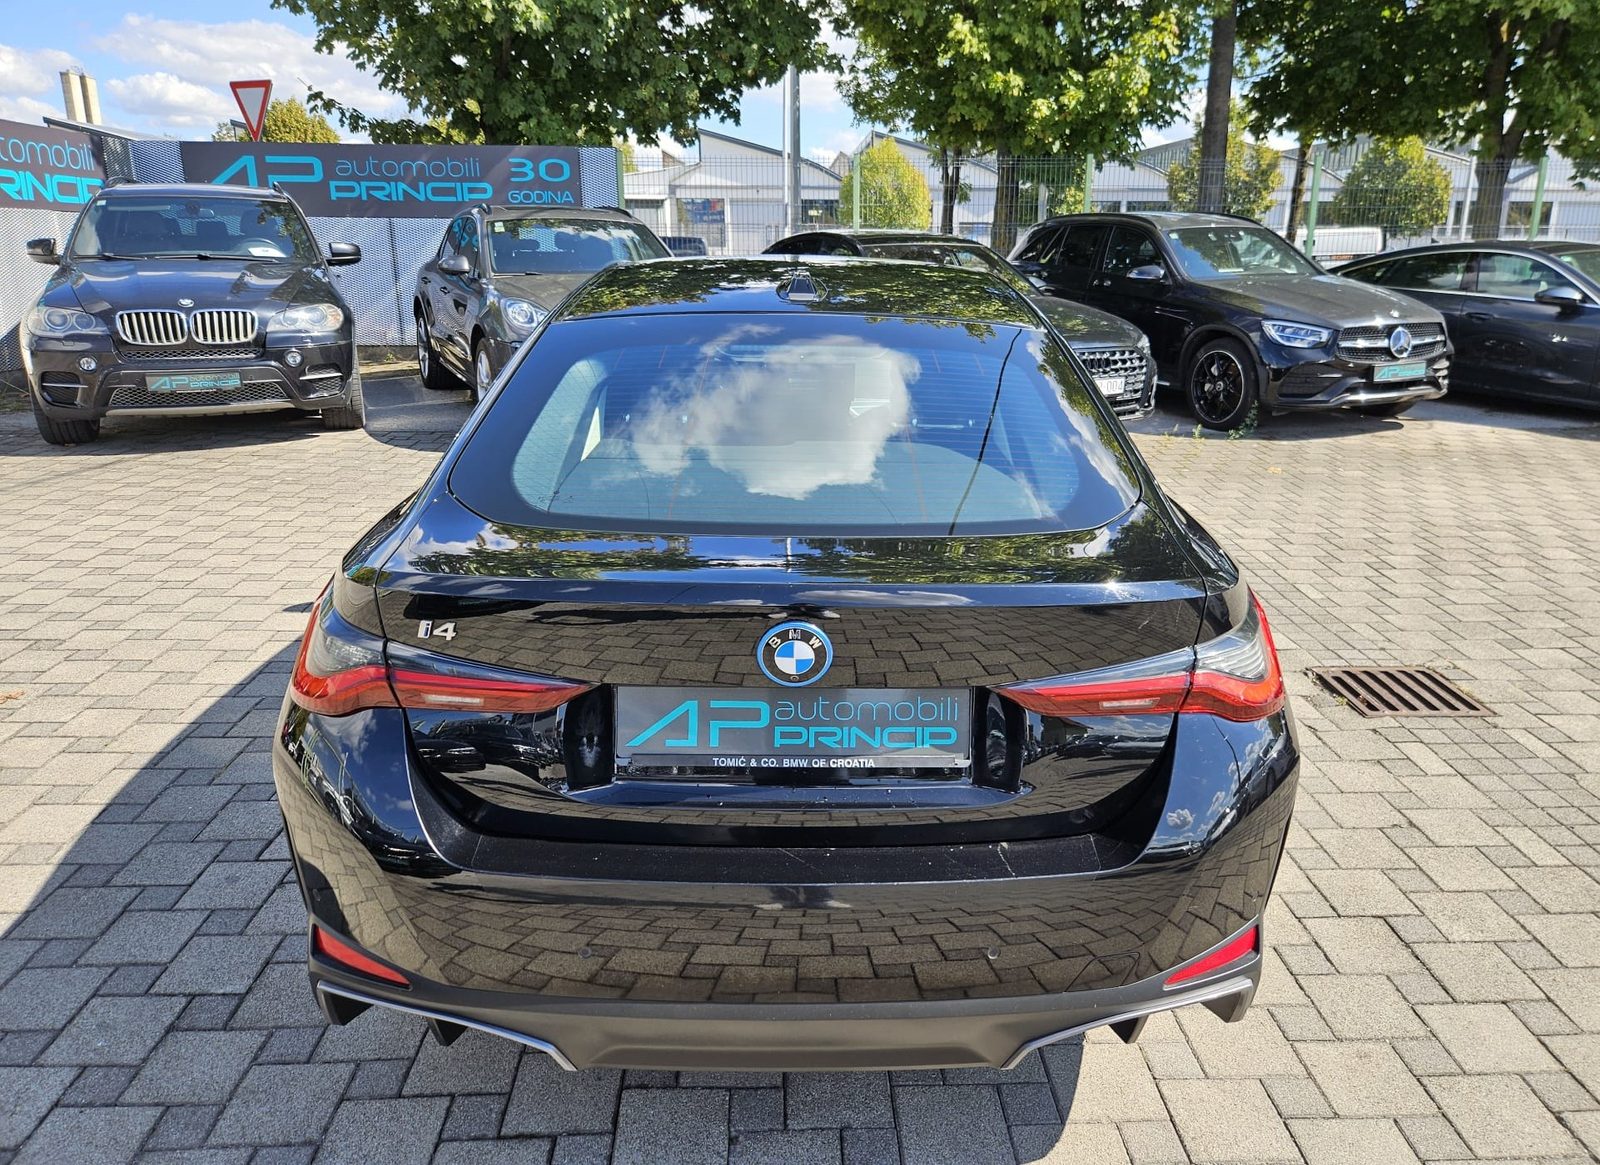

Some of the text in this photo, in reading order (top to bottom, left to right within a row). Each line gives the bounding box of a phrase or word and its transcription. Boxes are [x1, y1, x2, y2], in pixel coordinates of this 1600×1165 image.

[211, 155, 324, 189] AP
[335, 156, 480, 178] automobili
[508, 158, 571, 182] 30
[329, 180, 493, 202] PRINCIP
[508, 190, 574, 204] GODINA
[150, 376, 189, 389] AP
[417, 620, 457, 641] i4
[768, 629, 822, 649] BMW
[774, 696, 958, 721] automobili
[625, 700, 770, 747] AP
[774, 726, 957, 748] PRINCIP
[712, 756, 875, 768] TOMIĆ & CO. BMW OF CROATIA
